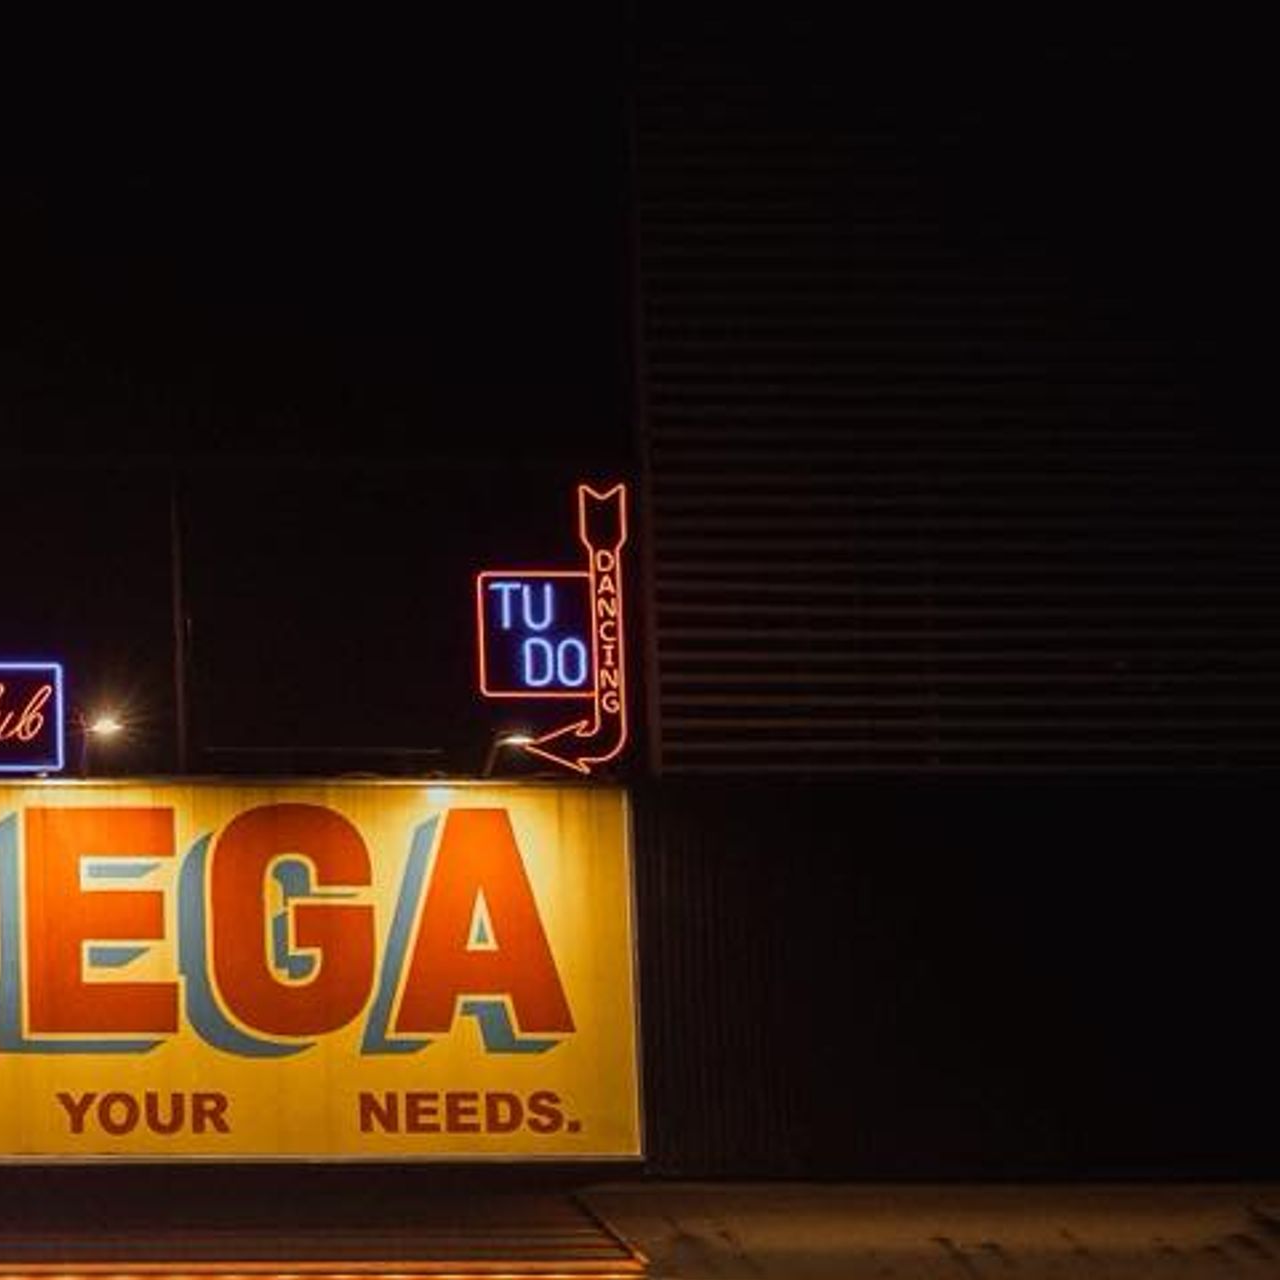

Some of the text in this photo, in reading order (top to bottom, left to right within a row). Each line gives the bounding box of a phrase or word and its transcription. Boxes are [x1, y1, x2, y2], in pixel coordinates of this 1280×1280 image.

[489, 582, 554, 631] TU
[595, 551, 621, 714] DANCING
[524, 637, 588, 687] DO
[57, 1092, 231, 1135] YOUR
[358, 1091, 582, 1135] NEEDS.
